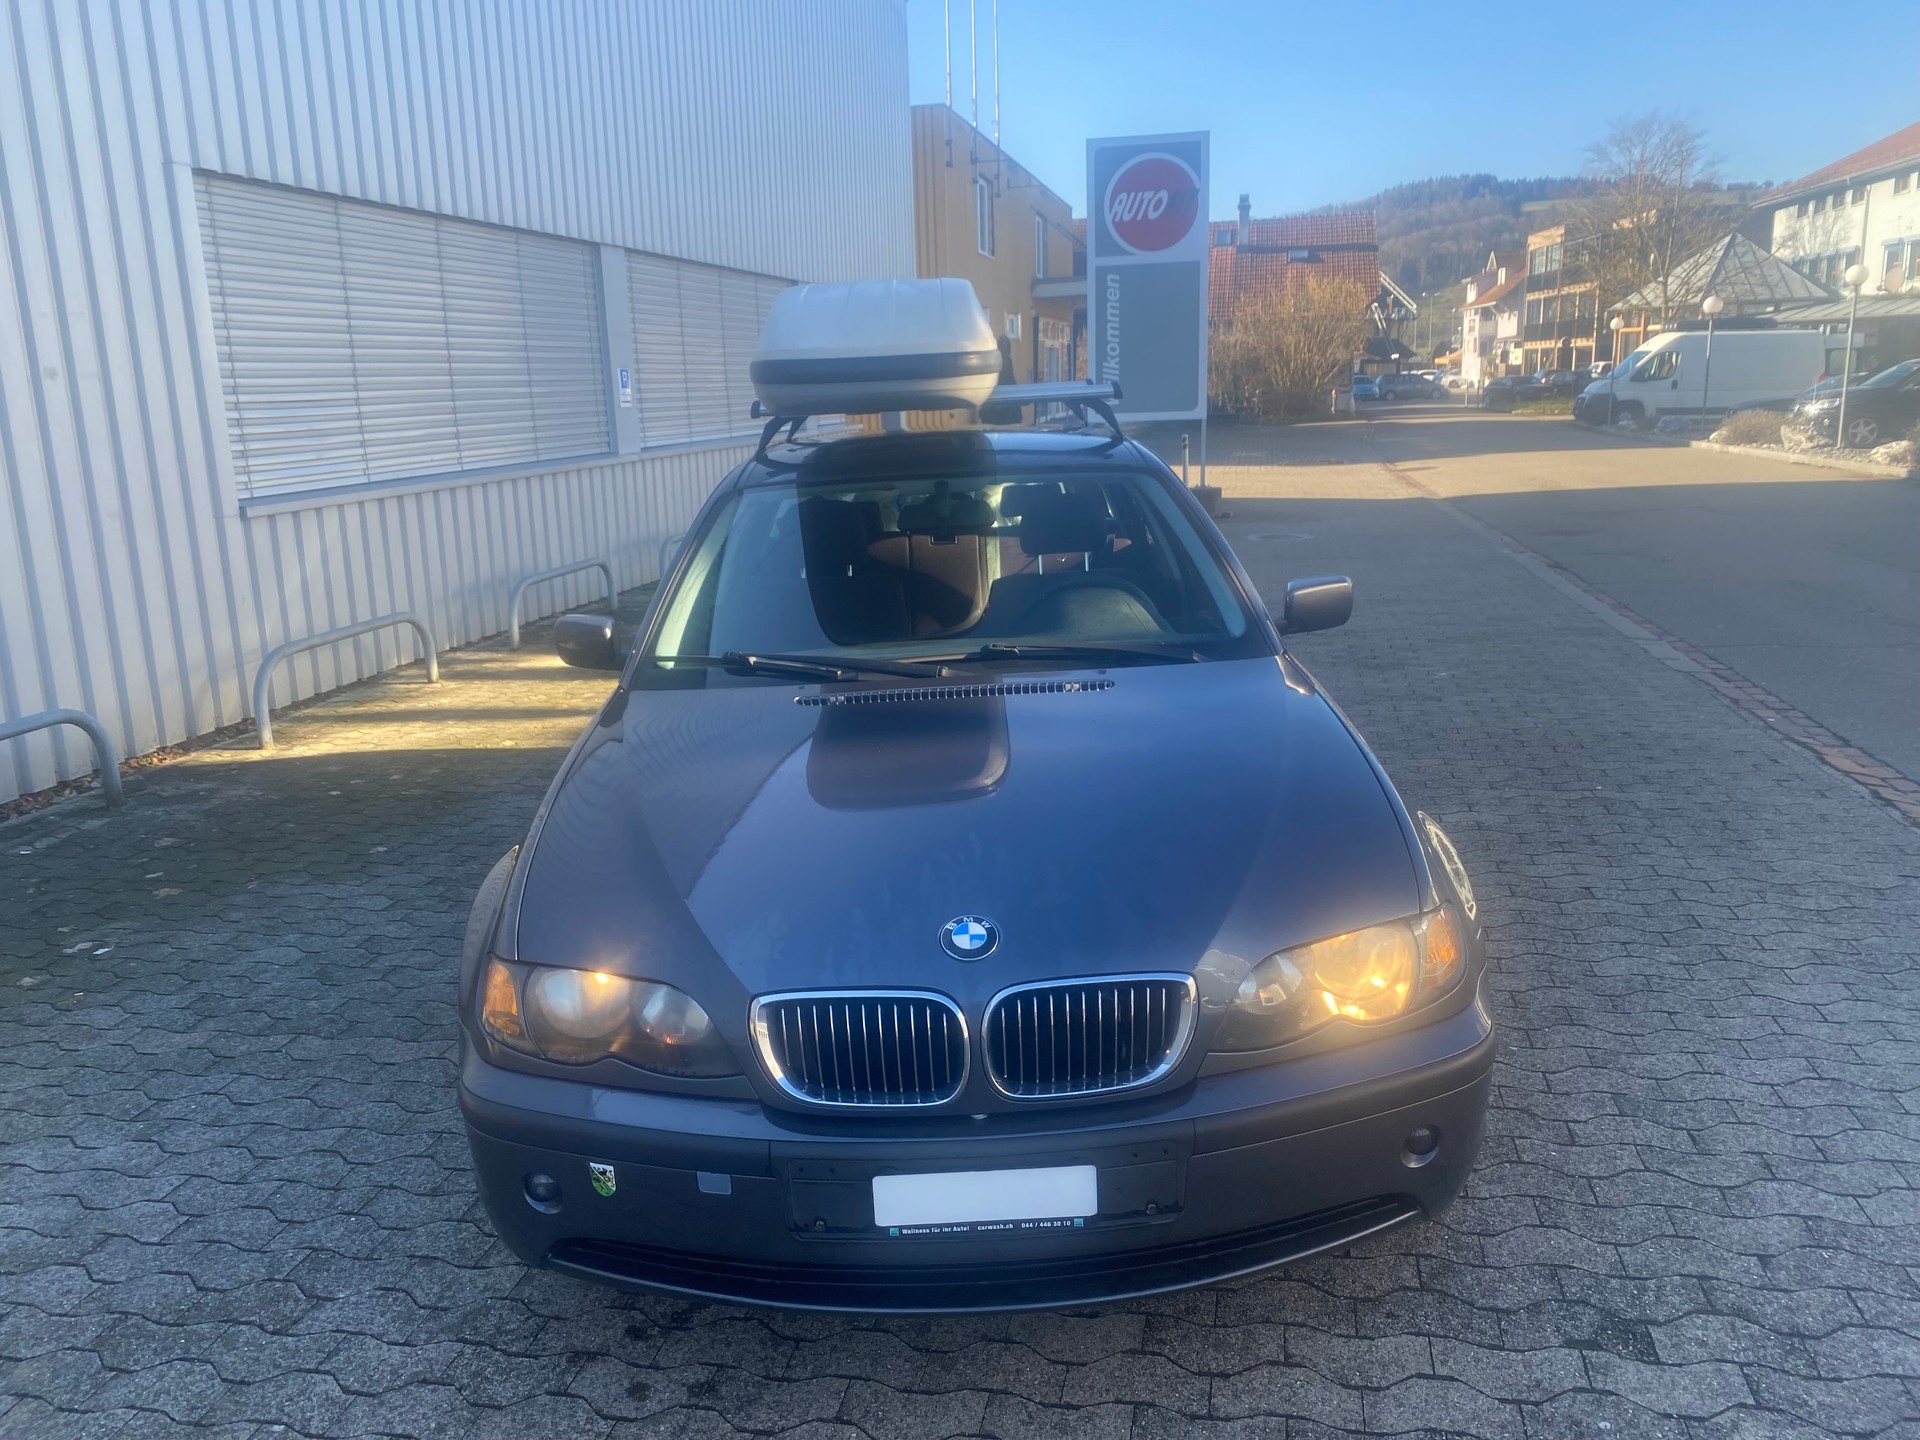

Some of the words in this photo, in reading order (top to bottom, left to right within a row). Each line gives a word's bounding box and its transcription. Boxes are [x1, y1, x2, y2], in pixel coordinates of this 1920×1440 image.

[947, 917, 992, 930] BMW
[901, 1227, 930, 1235] Wellness
[977, 1223, 1014, 1231] carwash.ch
